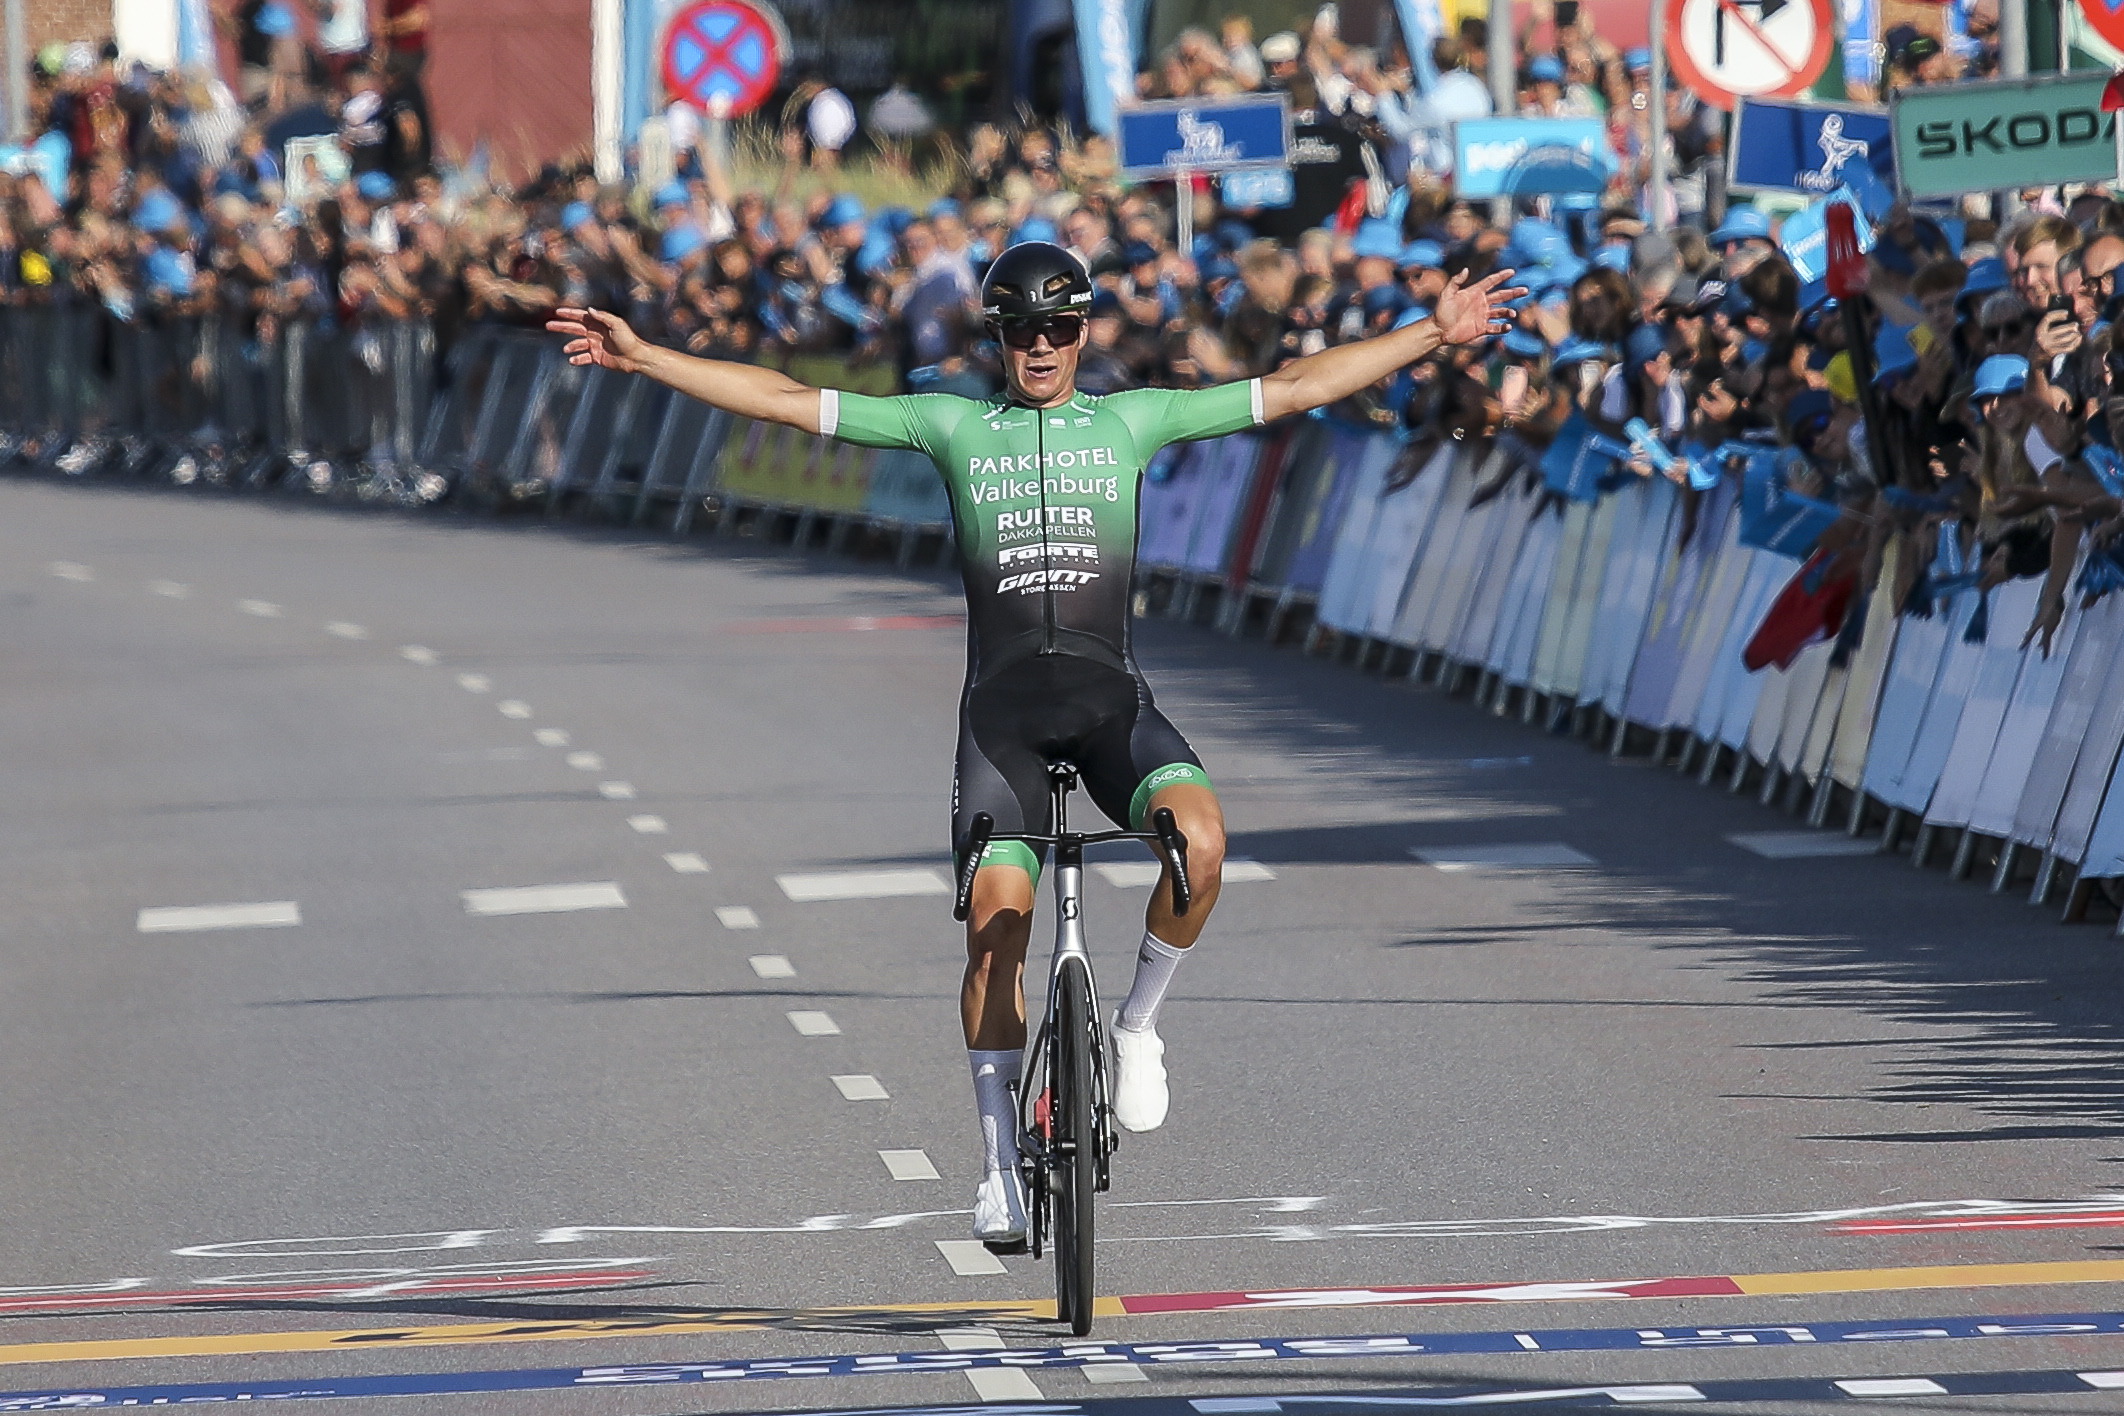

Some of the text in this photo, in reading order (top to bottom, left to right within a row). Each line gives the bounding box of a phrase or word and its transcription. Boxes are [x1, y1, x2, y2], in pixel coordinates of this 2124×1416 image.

[968, 446, 1119, 477] PARKHOTEL
[969, 472, 1119, 505] Valkenburg
[997, 506, 1094, 531] RUITER
[998, 525, 1097, 543] DAKKAPELLEN
[998, 542, 1099, 565] FORTE
[996, 569, 1101, 594] GIANT
